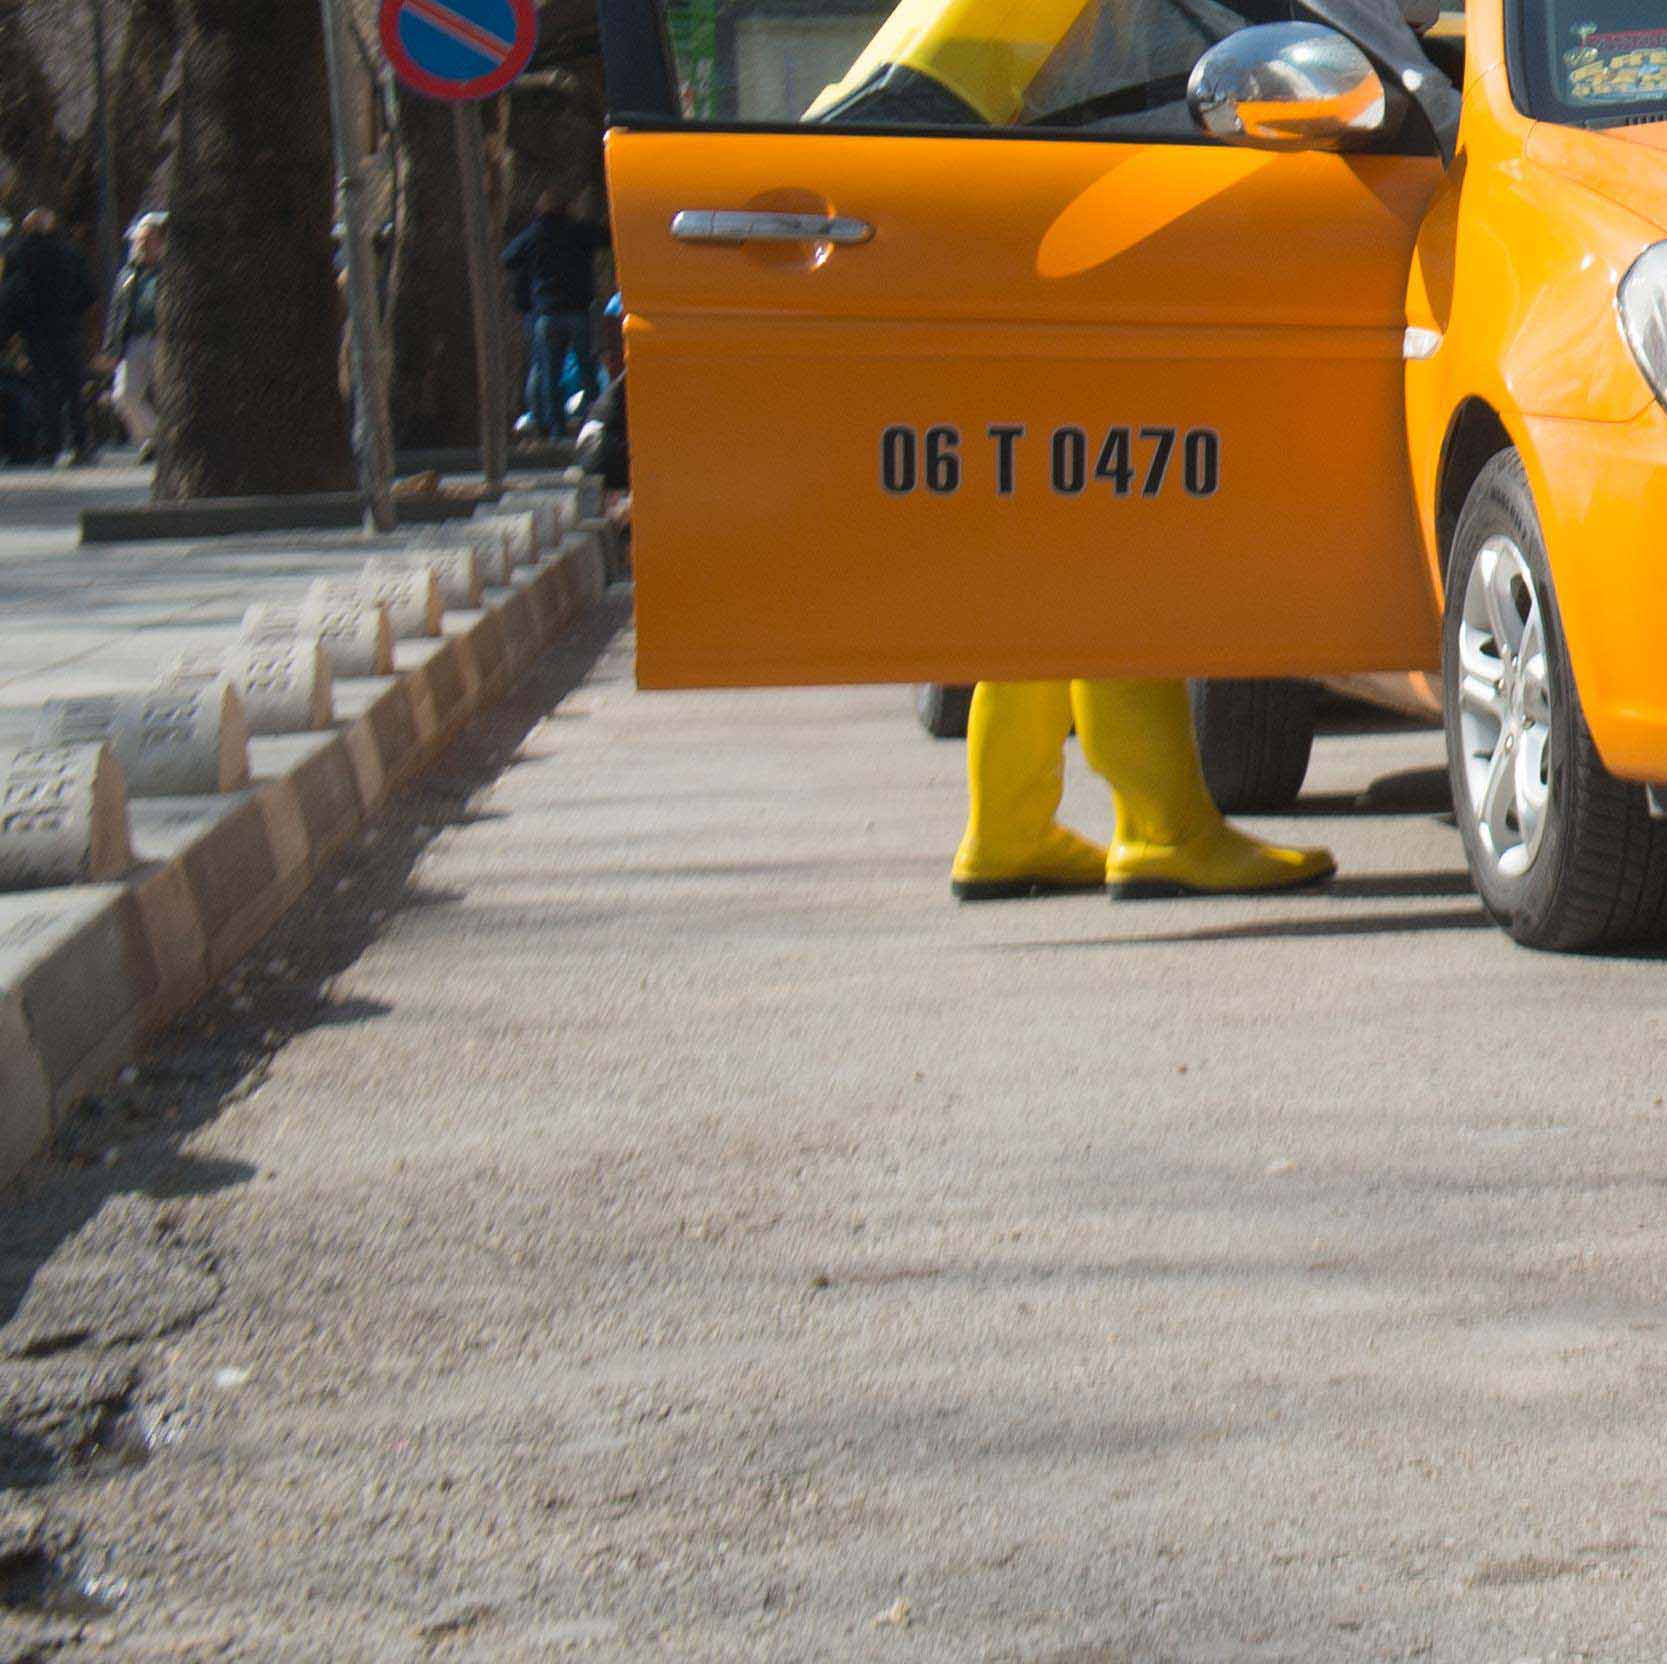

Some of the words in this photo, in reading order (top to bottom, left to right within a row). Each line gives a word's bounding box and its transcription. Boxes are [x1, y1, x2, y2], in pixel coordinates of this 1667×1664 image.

[880, 423, 962, 497] 06
[986, 423, 1027, 497] T
[1048, 424, 1221, 499] 0470
